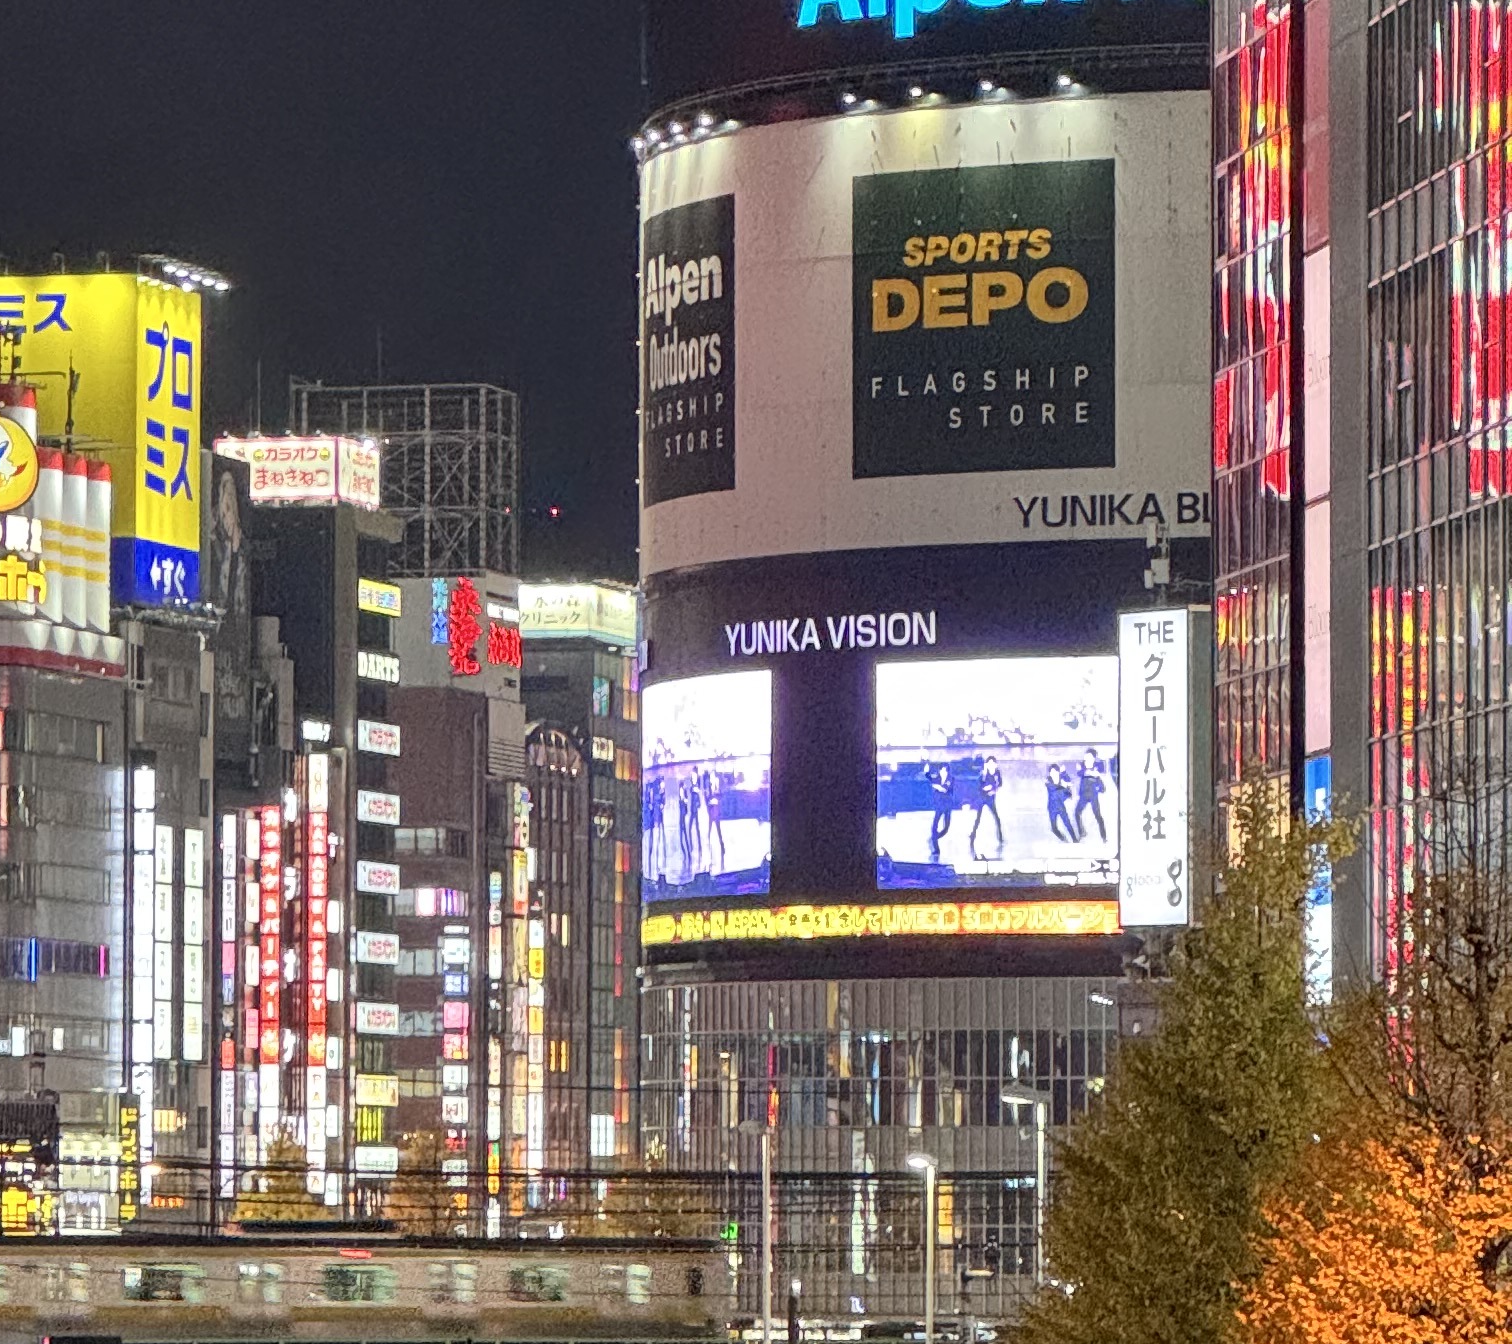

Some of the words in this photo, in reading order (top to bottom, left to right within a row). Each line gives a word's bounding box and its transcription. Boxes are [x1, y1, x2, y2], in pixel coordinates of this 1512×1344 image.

[902, 228, 1053, 267] SPORTS
[644, 253, 723, 328] Alpen
[871, 266, 1090, 333] DEPO
[649, 331, 722, 391] Outdoors
[871, 365, 1091, 399] FLAGSHIP
[645, 393, 725, 428] FLAGSHIP
[948, 401, 1090, 428] STORE
[265, 447, 318, 461] カラオケ
[664, 434, 724, 457] STORE
[254, 466, 330, 490] まねきねこ
[1012, 492, 1166, 529] YUNIKA
[724, 617, 821, 656] YUNIKA
[827, 611, 936, 650] VISION
[1133, 619, 1174, 645] THE
[357, 652, 400, 684] DARTS
[1142, 652, 1167, 841] グローバル社
